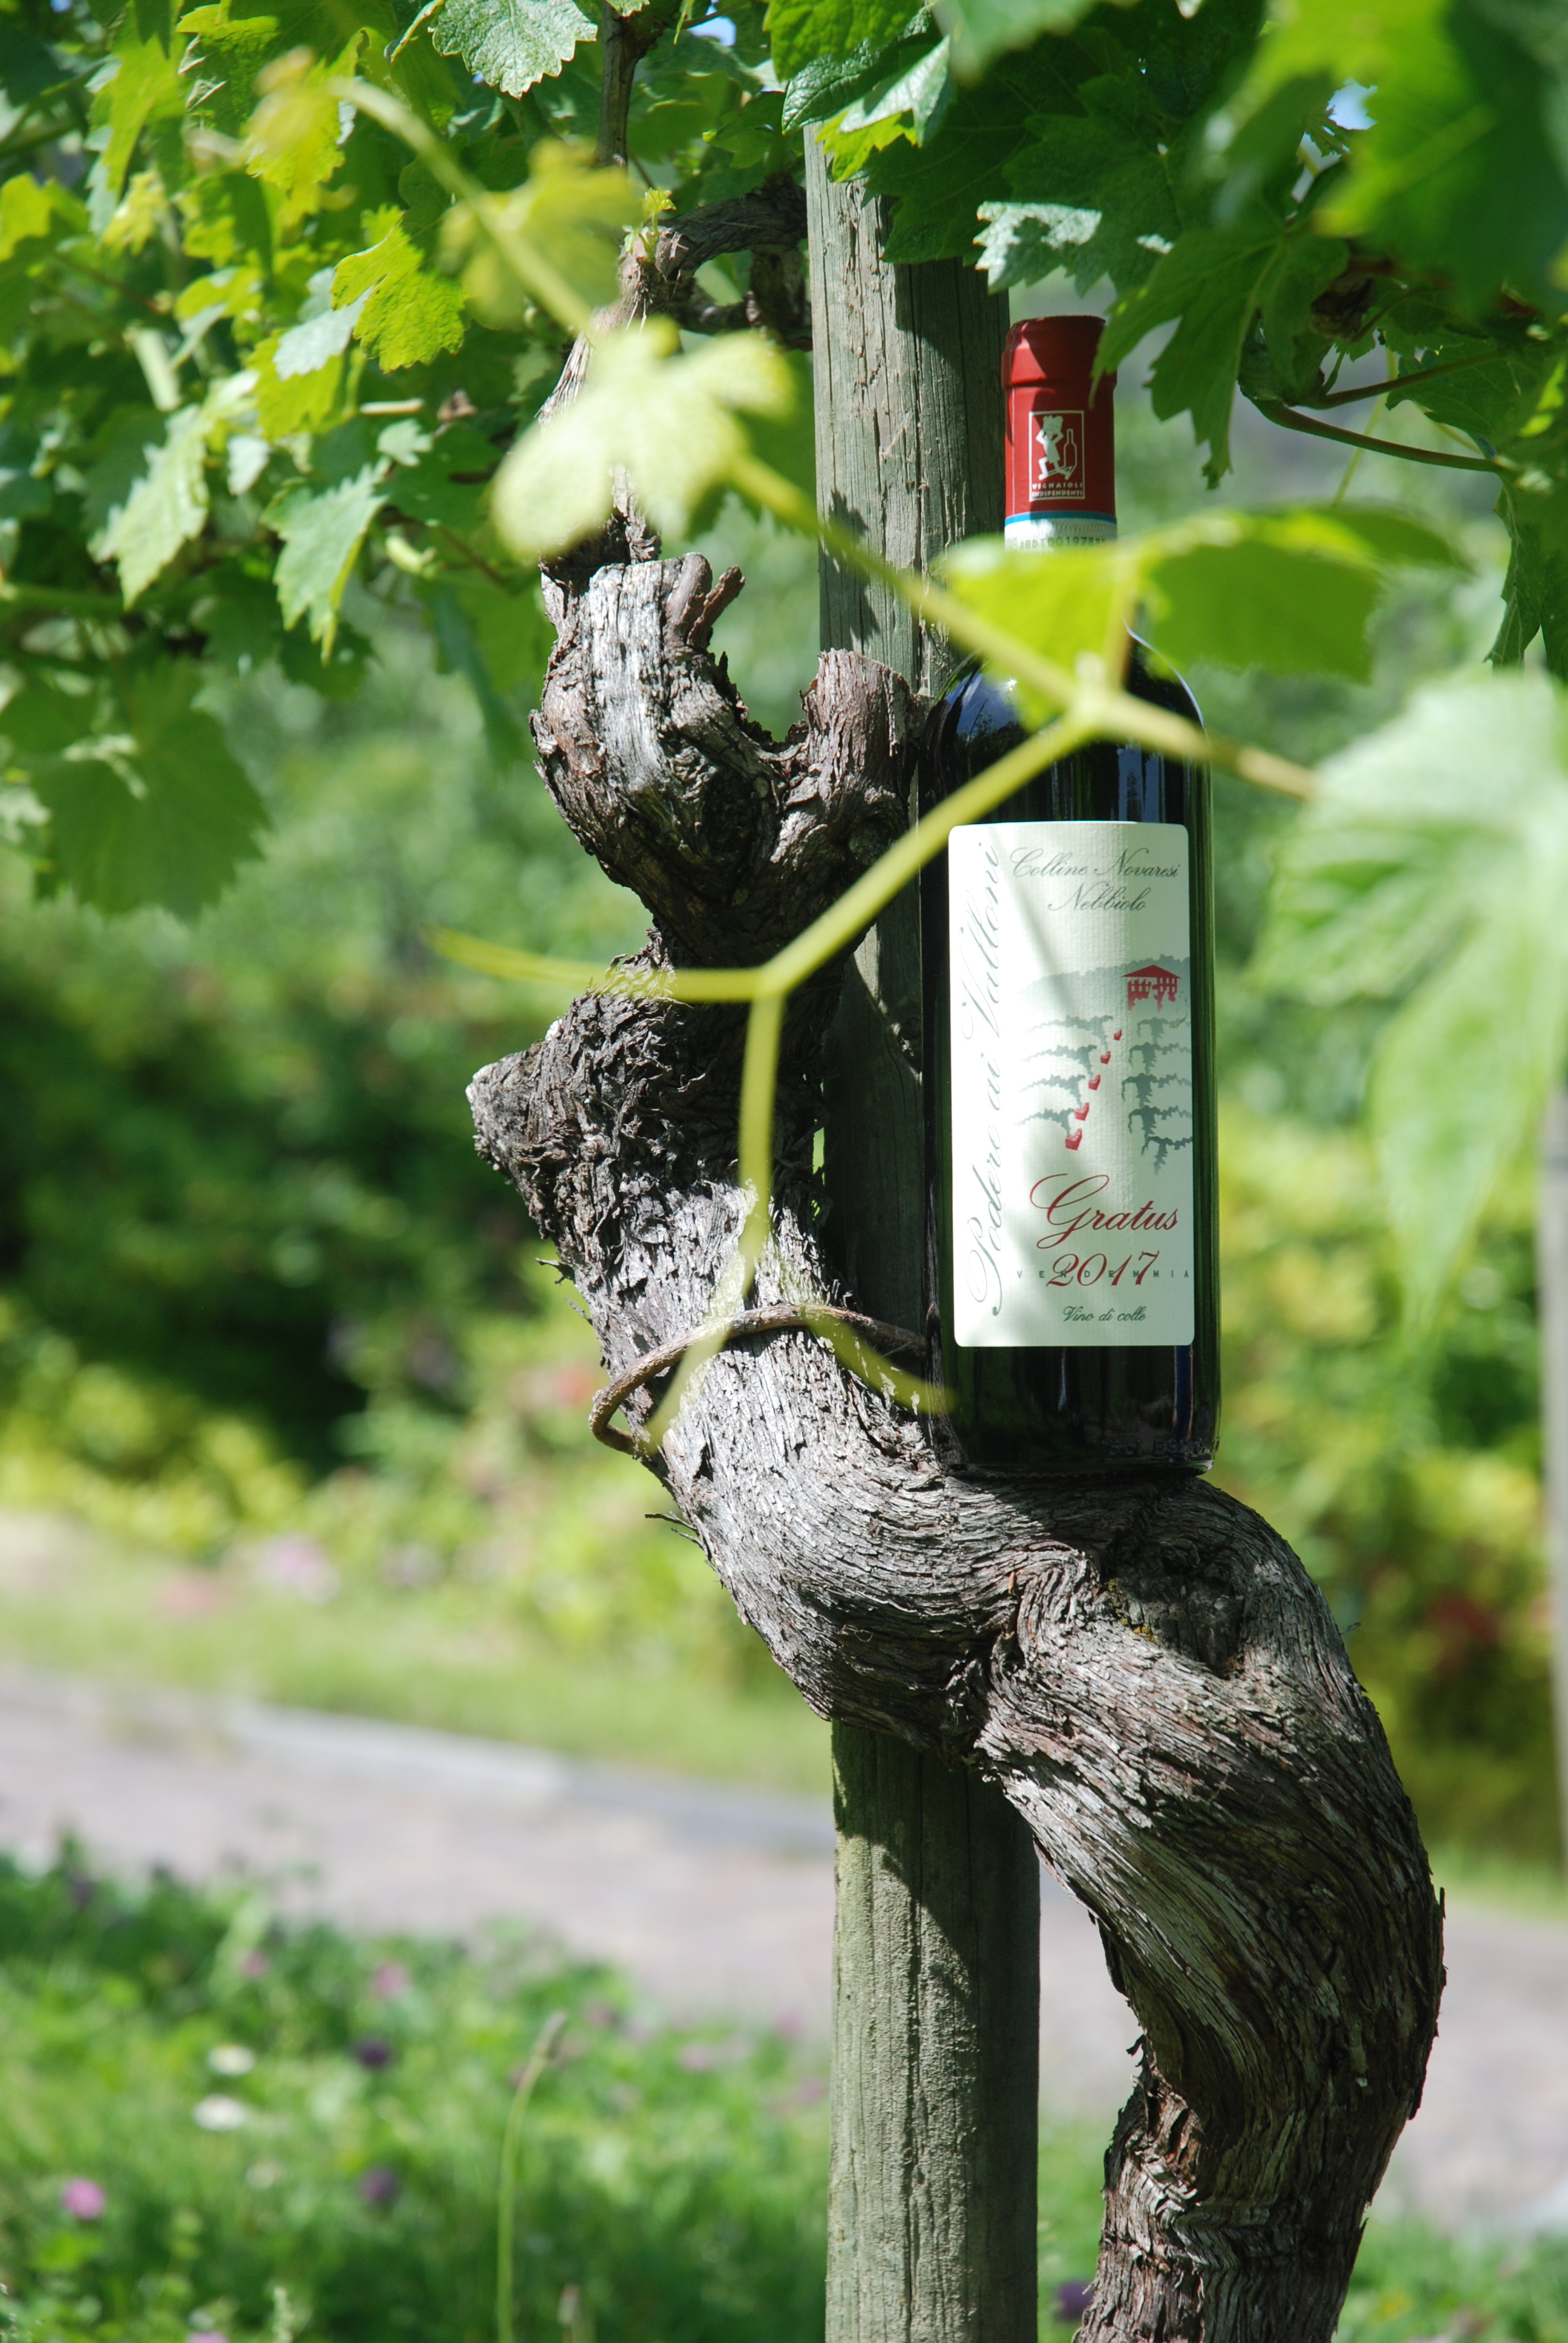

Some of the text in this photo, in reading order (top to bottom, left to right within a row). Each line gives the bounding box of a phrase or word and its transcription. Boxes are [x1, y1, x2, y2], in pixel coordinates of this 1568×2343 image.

[1032, 482, 1083, 490] VIGNAIOLI
[1032, 490, 1083, 498] INDIPENDENTI
[1010, 847, 1181, 878] Colline Novaresi
[1048, 881, 1152, 911] Nebbiolo
[959, 842, 1002, 1317] Podere ai Valloni
[1030, 1173, 1178, 1250] Gratus
[1046, 1250, 1160, 1288] 2017
[1063, 1305, 1146, 1322] Vino di colle
